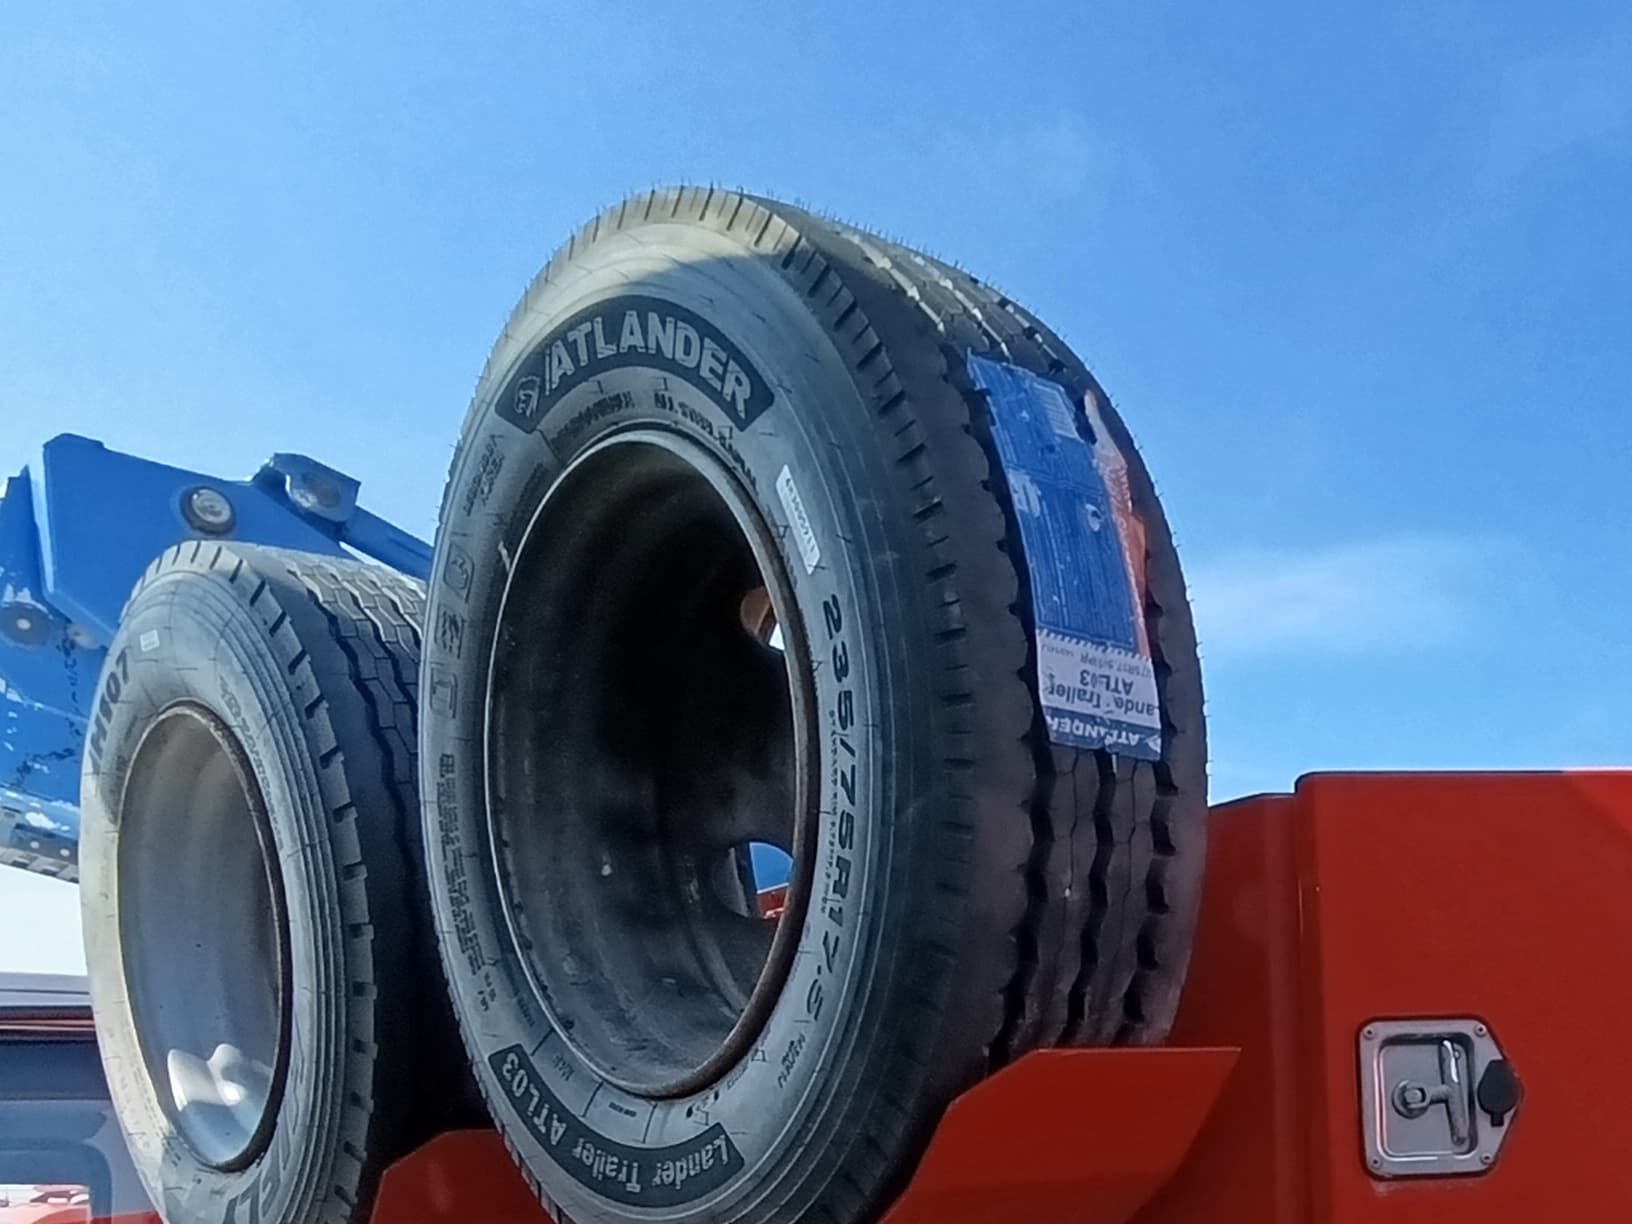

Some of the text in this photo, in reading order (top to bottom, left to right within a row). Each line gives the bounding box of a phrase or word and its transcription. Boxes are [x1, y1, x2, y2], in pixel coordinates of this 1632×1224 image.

[545, 309, 752, 419] ATLANDER
[1104, 694, 1160, 717] ande
[806, 593, 856, 1022] 235/75R17.5
[501, 1051, 567, 1146] ATL03
[573, 1137, 642, 1194] Trailer
[652, 1134, 730, 1190] Lander
